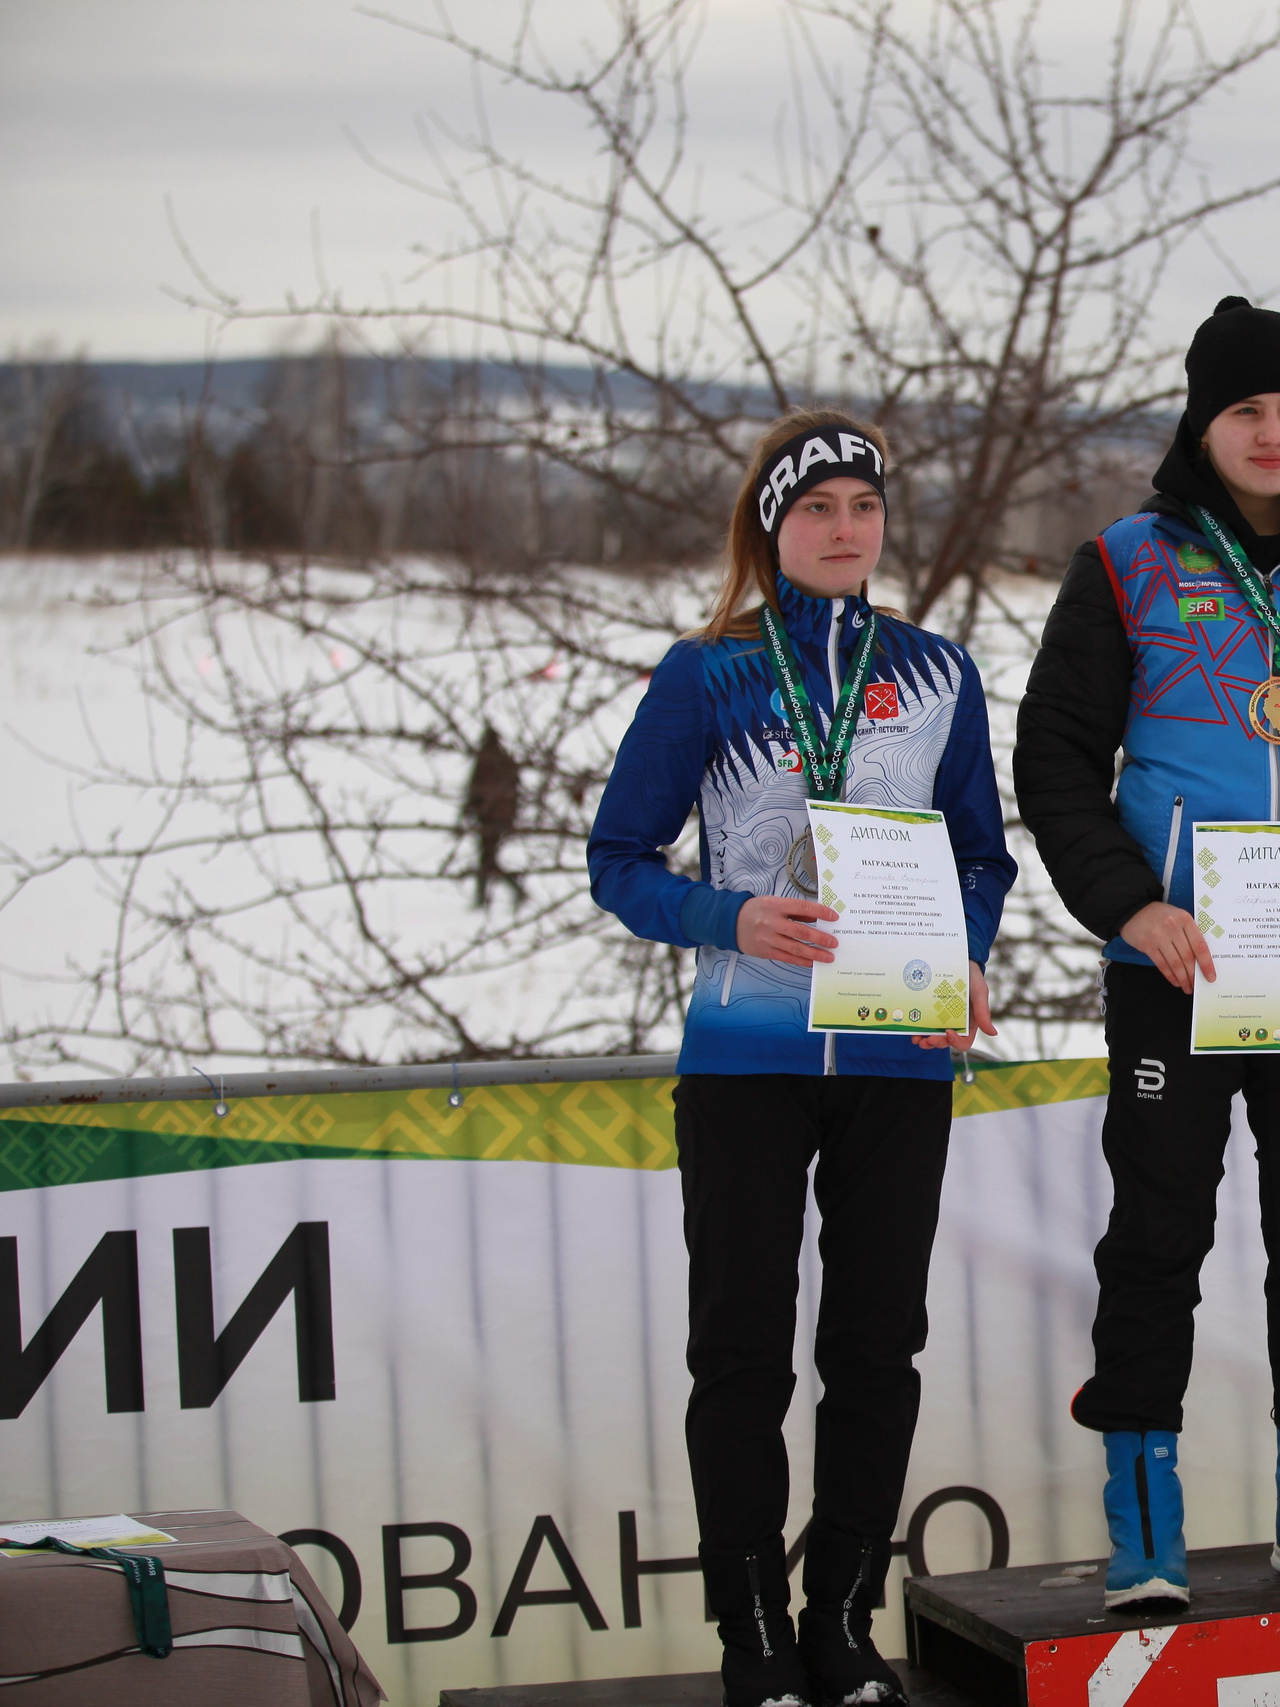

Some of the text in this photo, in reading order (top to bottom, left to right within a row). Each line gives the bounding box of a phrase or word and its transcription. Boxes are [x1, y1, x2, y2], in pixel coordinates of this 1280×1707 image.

[759, 432, 883, 532] CRAFT
[1214, 528, 1248, 578] СПОРТИВНЫЕ
[1187, 601, 1215, 614] SFR
[781, 666, 804, 719] СПОРТИВНЫЕ
[828, 719, 850, 789] ЕРОССИЙСКИЕ
[845, 668, 864, 718] СПОРТИВНЫЕ
[777, 759, 793, 768] SFR
[798, 720, 824, 791] ВСЕРОССИЙСКИЕ
[851, 826, 911, 842] ДИПЛОМ
[862, 859, 919, 869] НАГРАЖДАЕТСЯ
[1137, 1091, 1163, 1100] DÆHLIE
[0, 1221, 336, 1420] ИИ
[277, 1486, 1010, 1644] ОВАНЮ
